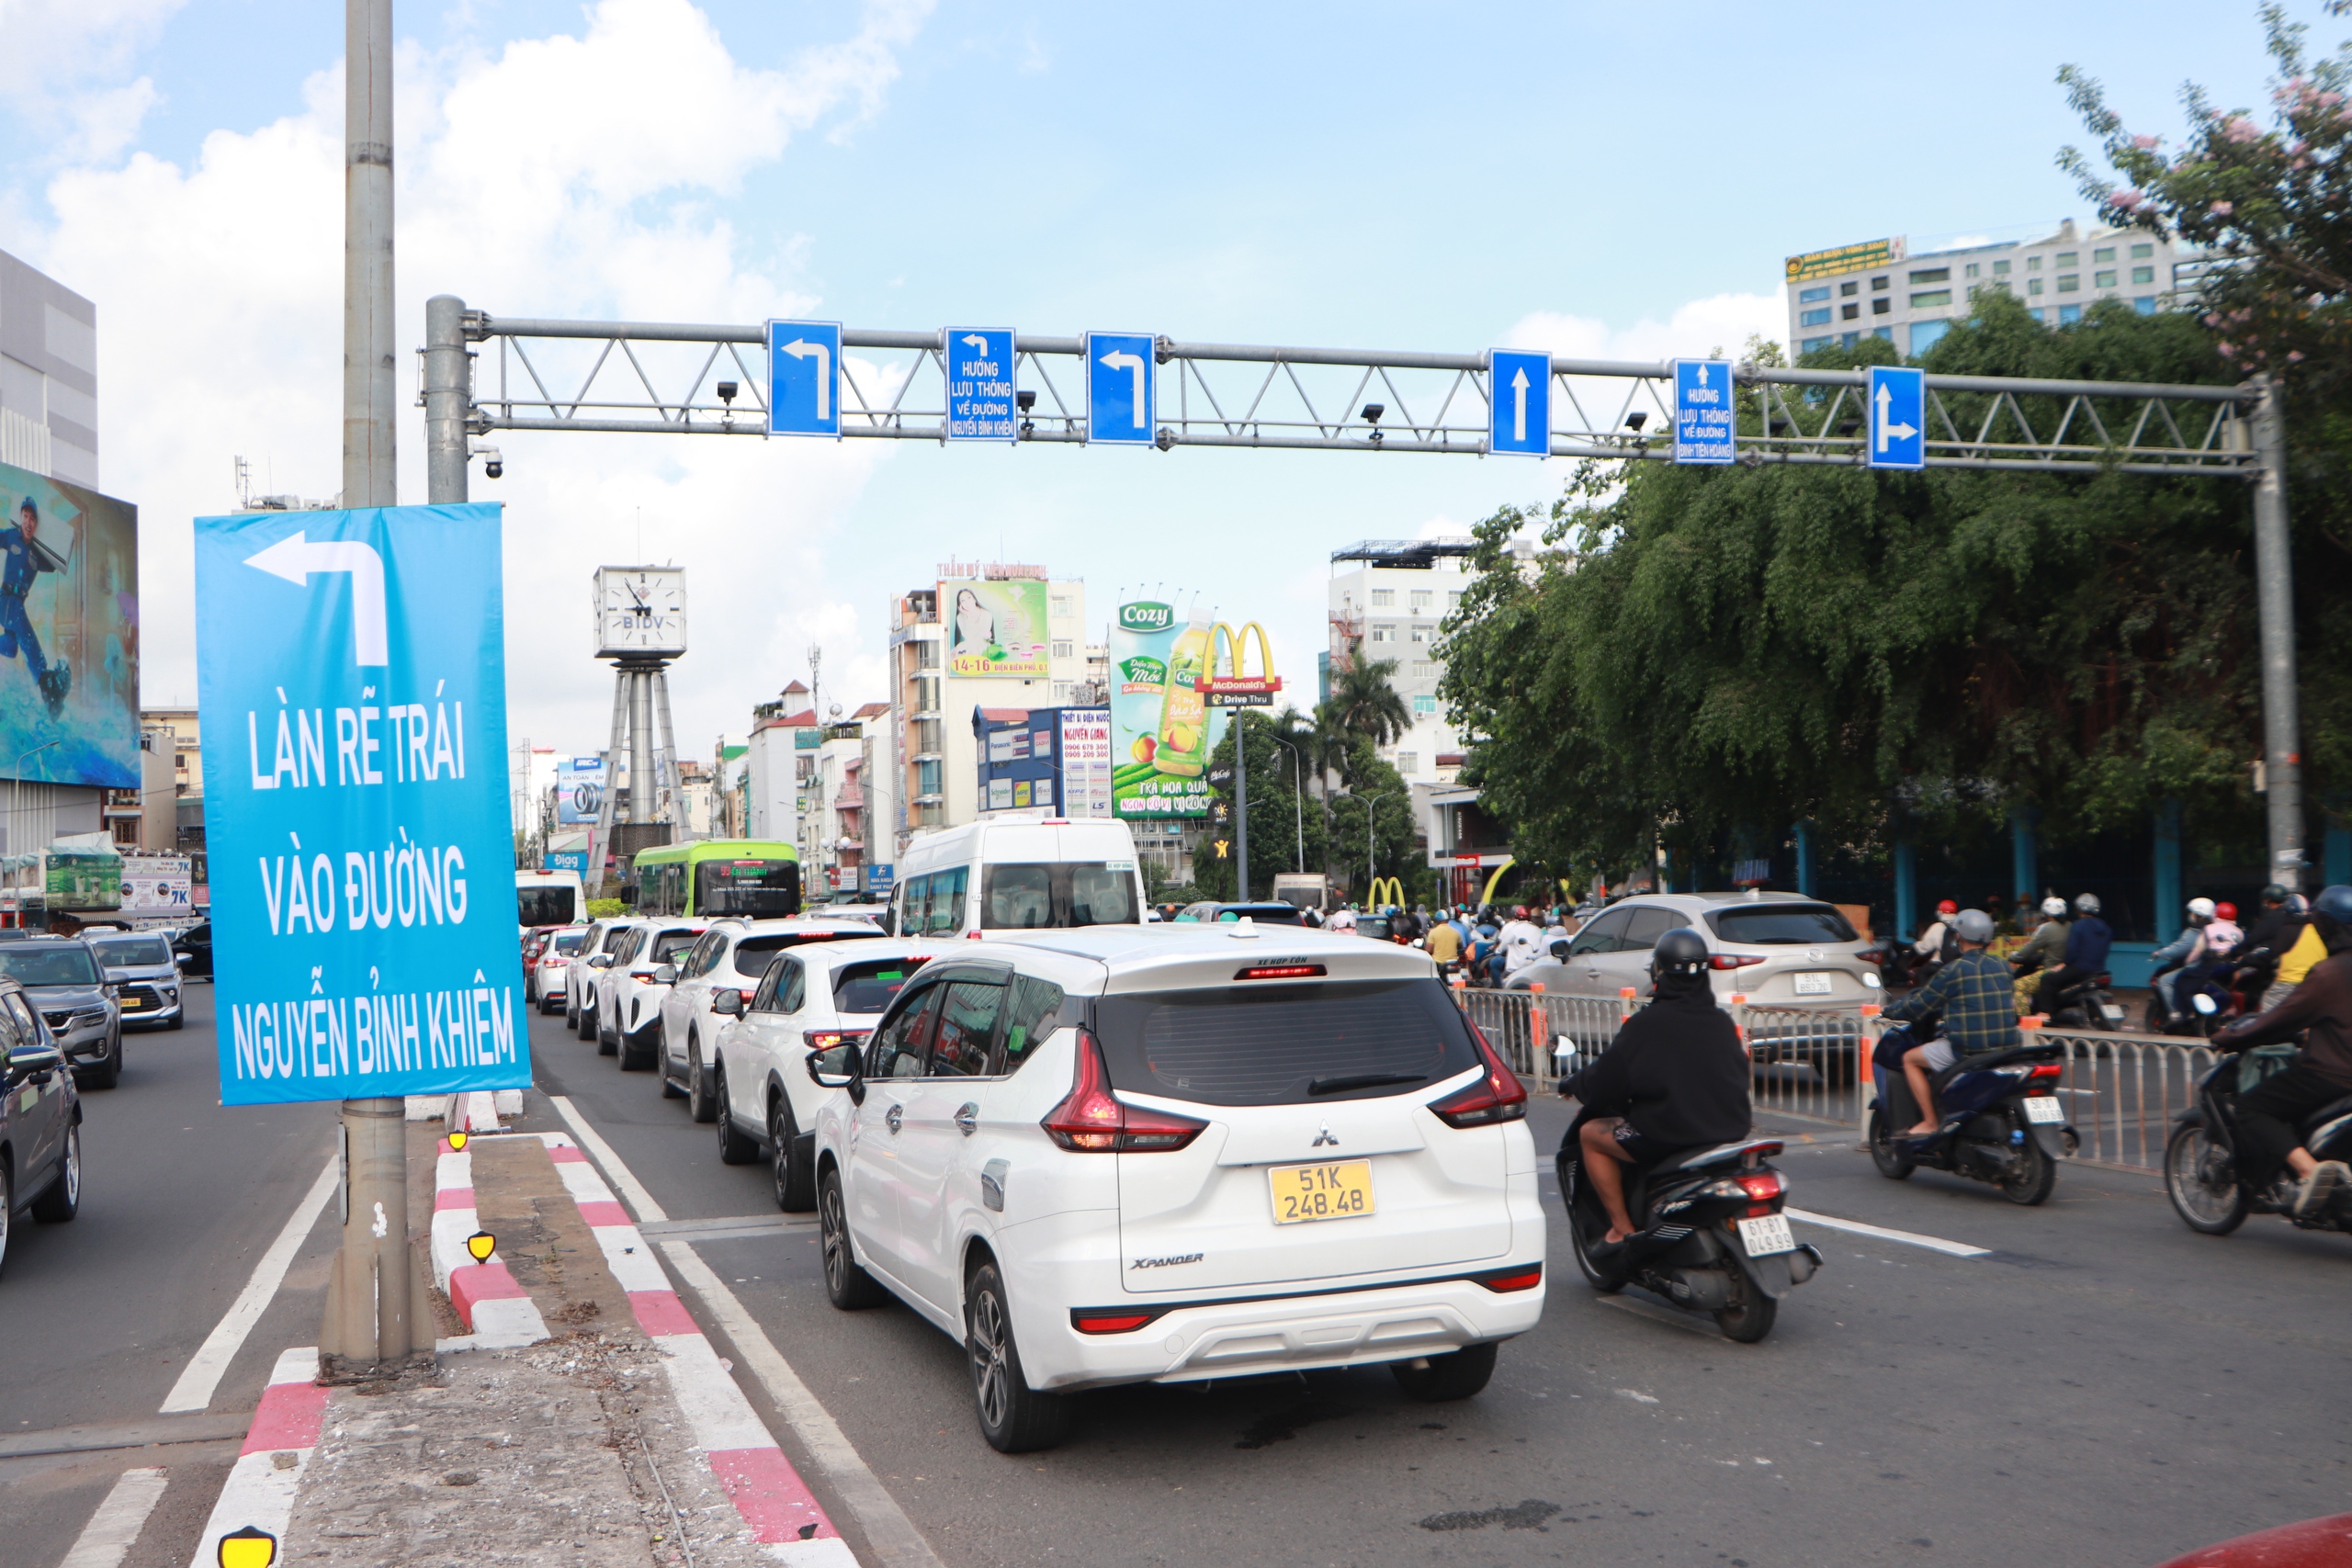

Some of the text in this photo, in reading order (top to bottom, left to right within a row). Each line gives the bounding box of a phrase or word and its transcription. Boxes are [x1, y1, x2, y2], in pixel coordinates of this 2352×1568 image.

[962, 357, 999, 377] HƯỚNG
[952, 378, 1012, 397] LƯU THÔNG
[1689, 385, 1719, 402] HƯỚNG
[956, 399, 1008, 415] VỀ ĐƯỜNG
[1680, 407, 1730, 423] LƯU THÔNG
[1683, 424, 1726, 438] VỀ ĐƯỜNG
[624, 616, 663, 629] BIDV
[1124, 605, 1168, 626] Cozy
[954, 660, 990, 671] 14-16
[1130, 659, 1147, 668] Diện
[1131, 669, 1162, 682] Mới
[1176, 671, 1195, 683] Coz
[1213, 681, 1266, 690] McDonald's
[1250, 694, 1267, 703] Thru
[1083, 711, 1094, 724] ĐIỆN
[1096, 711, 1110, 723] NƯỚC
[248, 679, 465, 790] LÀN RẼ TRÁI
[1064, 724, 1108, 740] NGUYỄN GIANG
[1139, 776, 1208, 795] TRÀ HOA QUẢ
[1121, 798, 1146, 811] NGON
[178, 861, 190, 872] 7K
[259, 826, 468, 935] VÀO ĐƯỜNG
[171, 890, 188, 905] 7K
[1805, 974, 1821, 982] 51L
[232, 964, 516, 1079] NGUYỄN BỈNH KHIÊM
[1299, 1166, 1342, 1191] 51K
[1284, 1189, 1364, 1218] 248.48
[1748, 1217, 1781, 1236] 61-B1
[1749, 1233, 1792, 1254] 049.99
[1129, 1253, 1204, 1270] XPANDER
